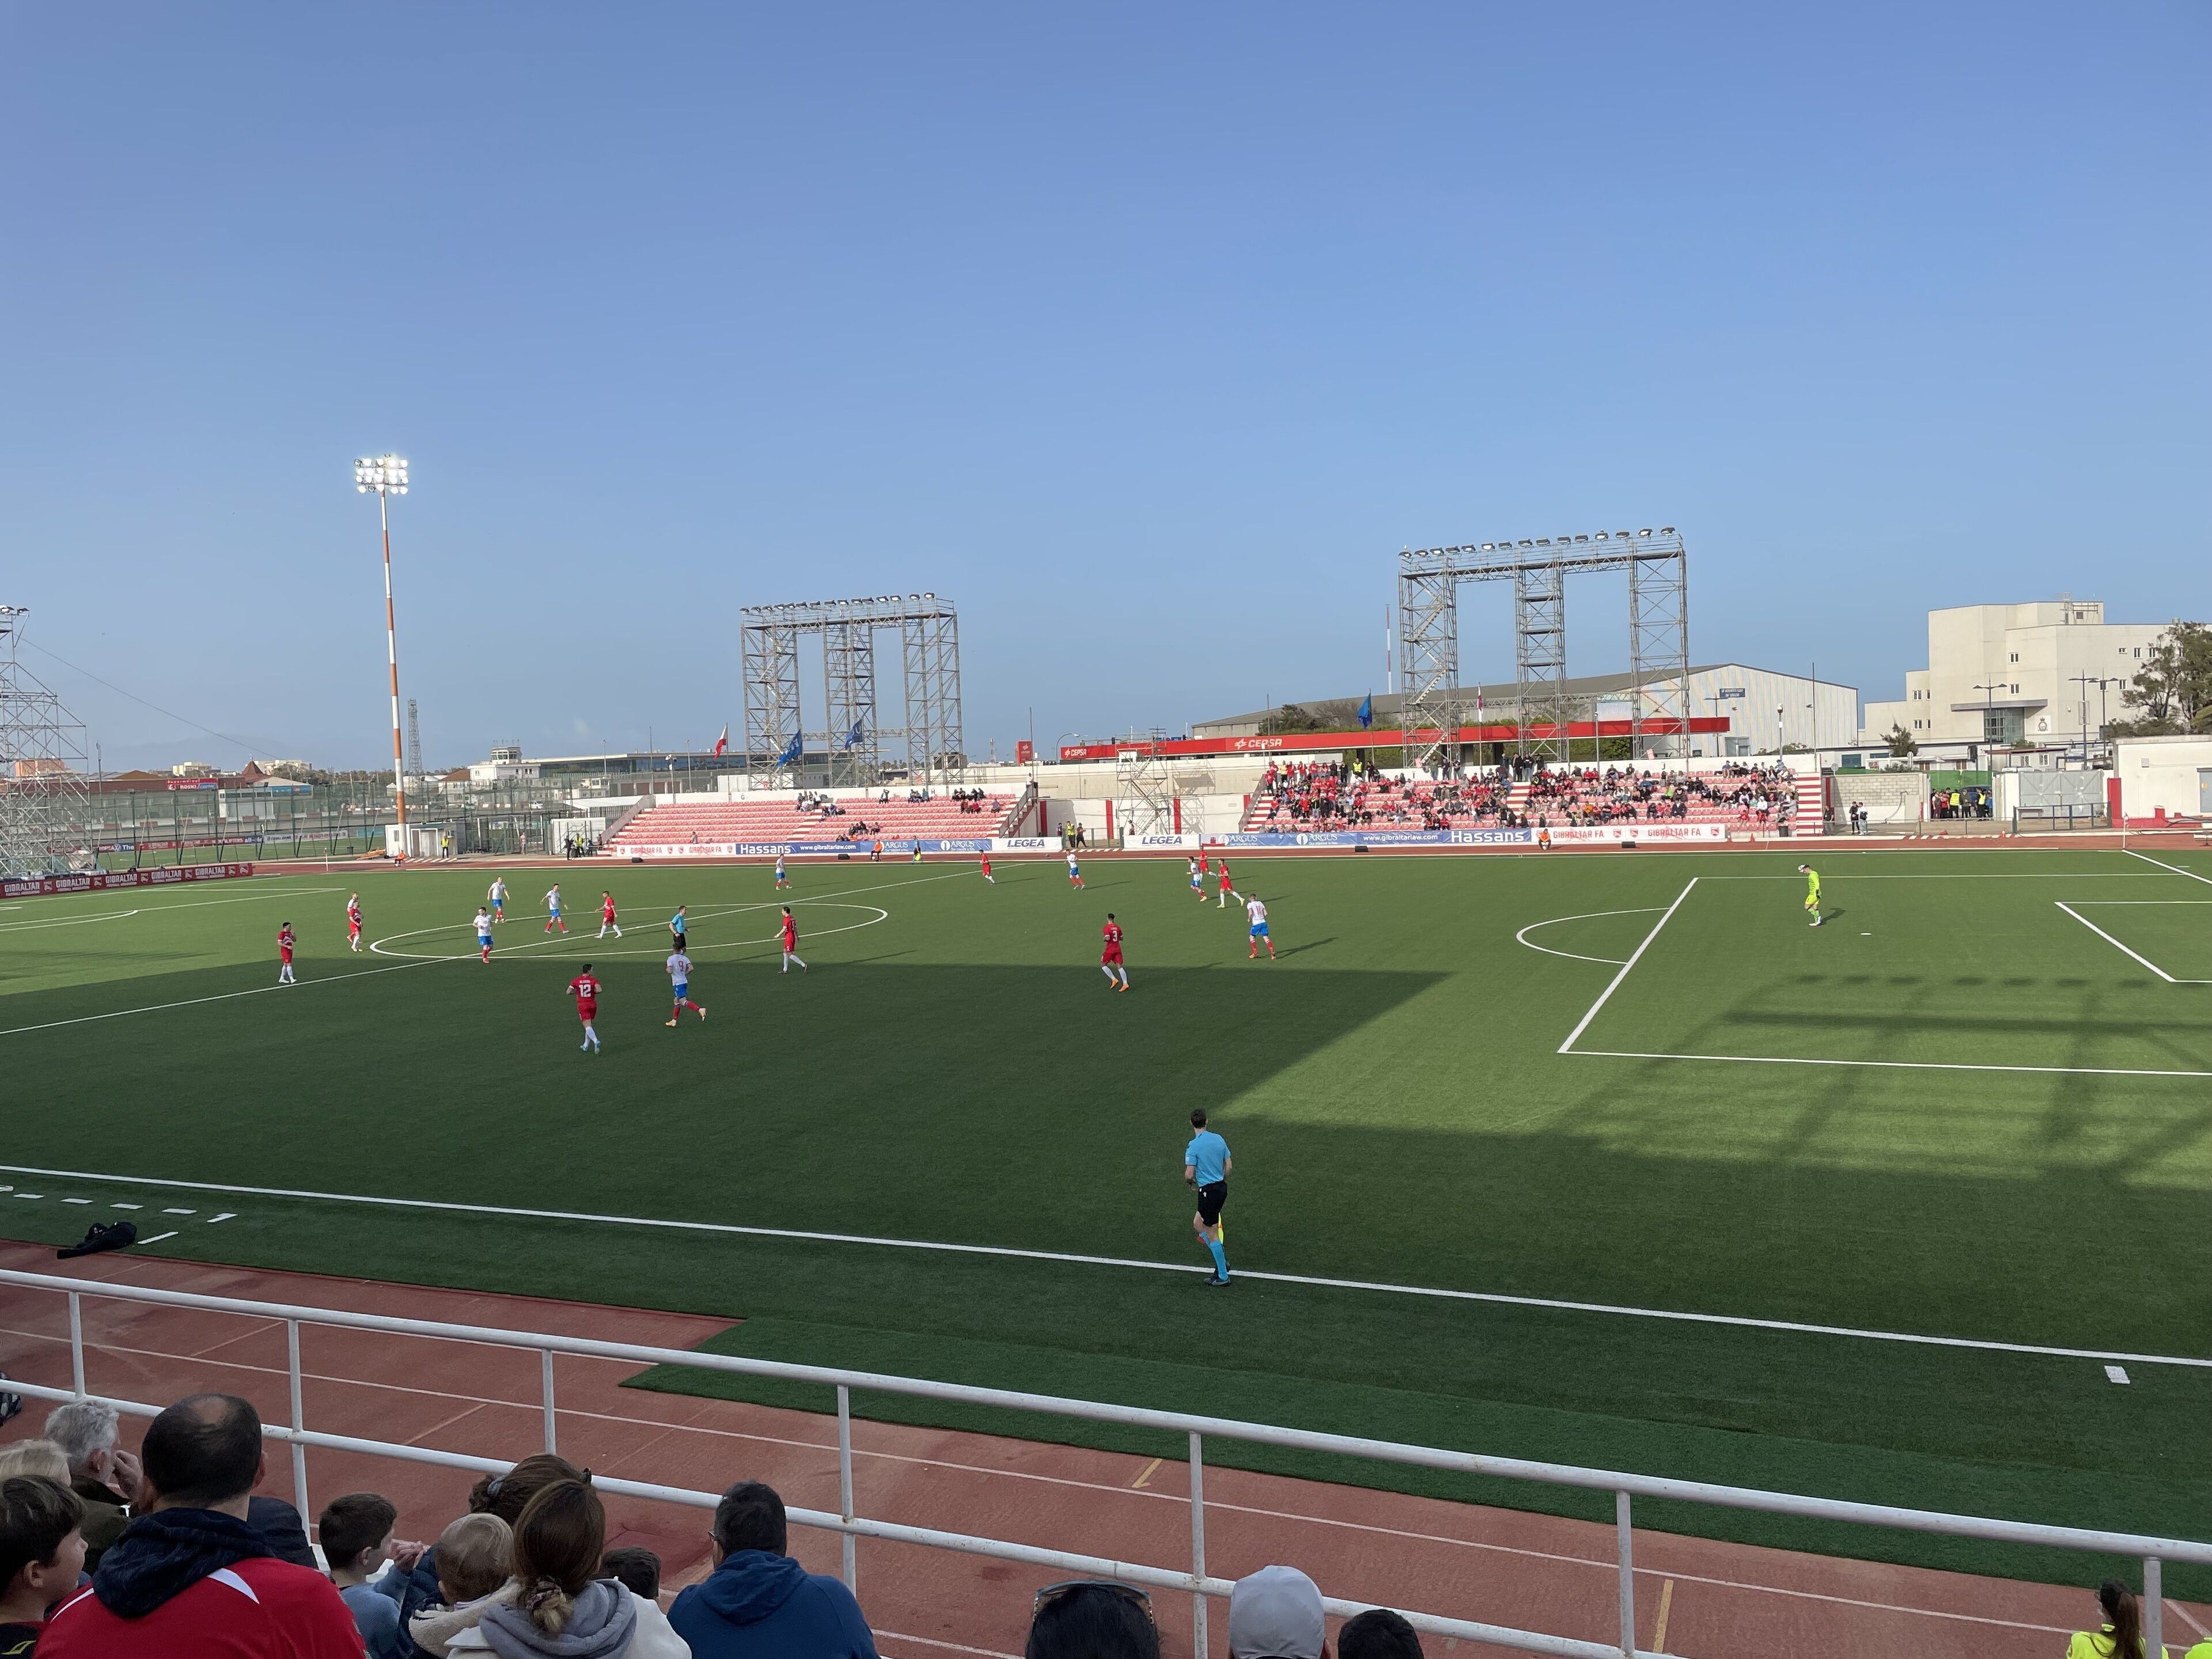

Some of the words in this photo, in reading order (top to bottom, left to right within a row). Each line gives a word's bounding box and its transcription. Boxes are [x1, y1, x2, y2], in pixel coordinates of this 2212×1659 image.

[1248, 738, 1282, 748] CEPSA
[1451, 831, 1524, 843] Hassans
[1553, 830, 1592, 838] GIBRALTAR
[1648, 828, 1689, 836] GIBRALTAR
[1691, 828, 1700, 836] FA
[1142, 836, 1183, 844] LEGEA
[1308, 833, 1338, 842] ARGUS
[1007, 839, 1045, 847] LEGEA
[740, 844, 792, 854] Hassans
[151, 870, 181, 880] GIBRALTAR
[195, 866, 225, 876] GIBRALTAR
[56, 877, 90, 888] GIBRALTAR
[105, 873, 138, 883] GIBRALTAR
[5, 882, 40, 892] GIBRALTAR
[1112, 930, 1118, 942] 3
[678, 961, 684, 972] 9
[579, 984, 591, 997] 12
